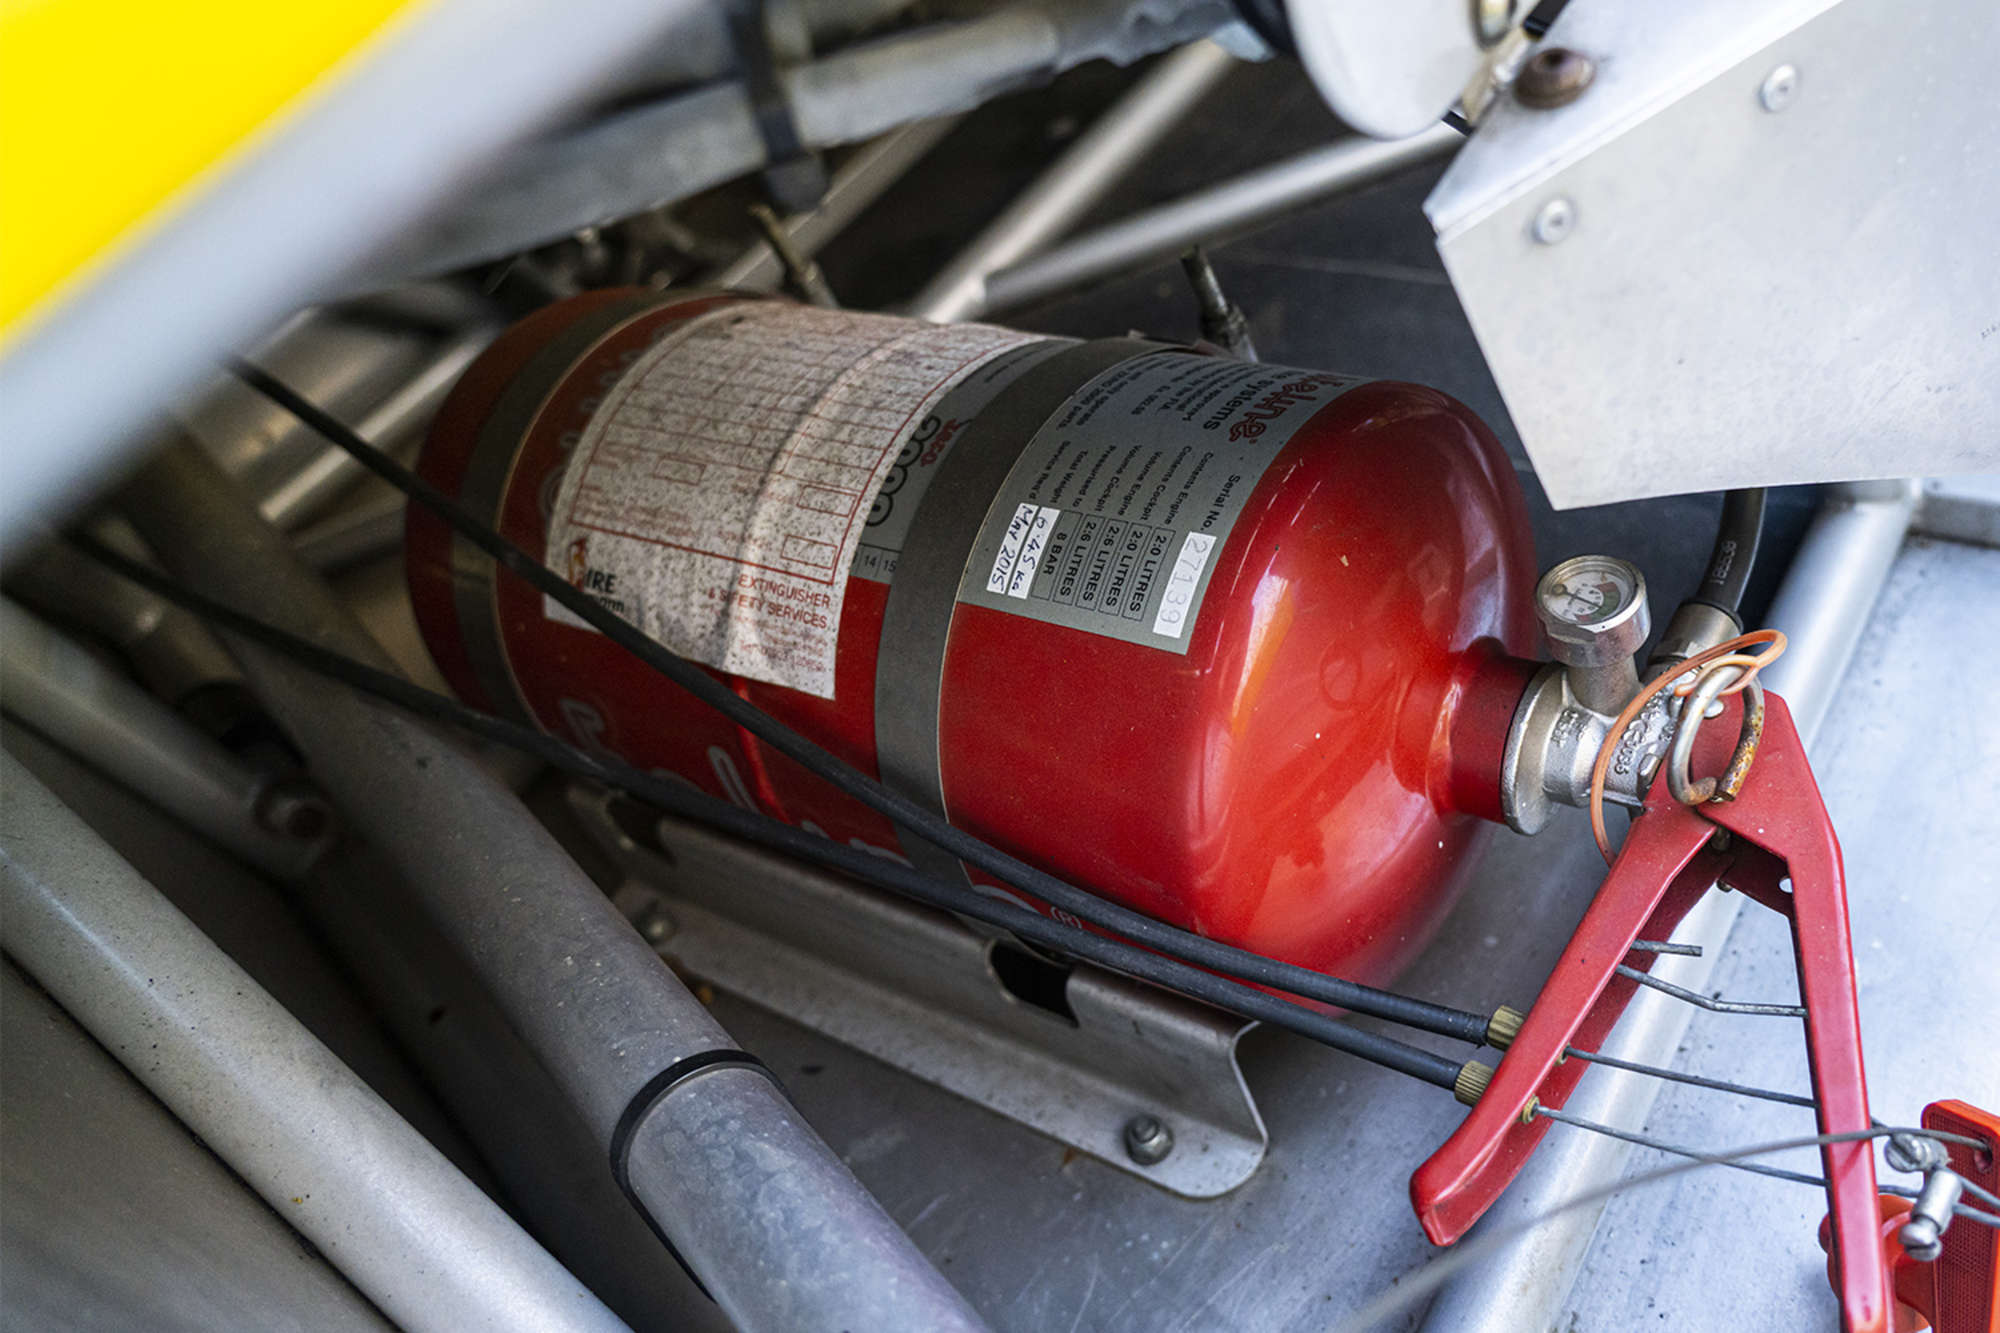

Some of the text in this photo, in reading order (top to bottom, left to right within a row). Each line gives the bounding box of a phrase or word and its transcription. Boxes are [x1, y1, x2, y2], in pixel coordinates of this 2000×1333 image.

[1044, 441, 1070, 470] Service
[1049, 450, 1088, 503] Total Weight
[1077, 445, 1116, 495] Pressurised
[1092, 444, 1142, 512] Volume Cockpit
[1114, 451, 1163, 515] Volume Engine
[1138, 445, 1192, 522] Contents Cockpit
[1161, 452, 1214, 525] Contents Engine
[1199, 474, 1241, 532] Serial No.
[990, 544, 1017, 591] 2015
[1041, 531, 1067, 574] 8 BAR
[1057, 521, 1097, 596] 2:6 LITRES
[1080, 525, 1120, 601] 2:6 LITRES
[1103, 530, 1144, 607] 2:0 LITRES
[1127, 534, 1167, 612] 2:0 LITRES
[1157, 537, 1209, 627] 27139
[718, 589, 765, 612] SFETY
[766, 601, 828, 629] SERVICES
[737, 573, 831, 609] EXTINGUISHER
